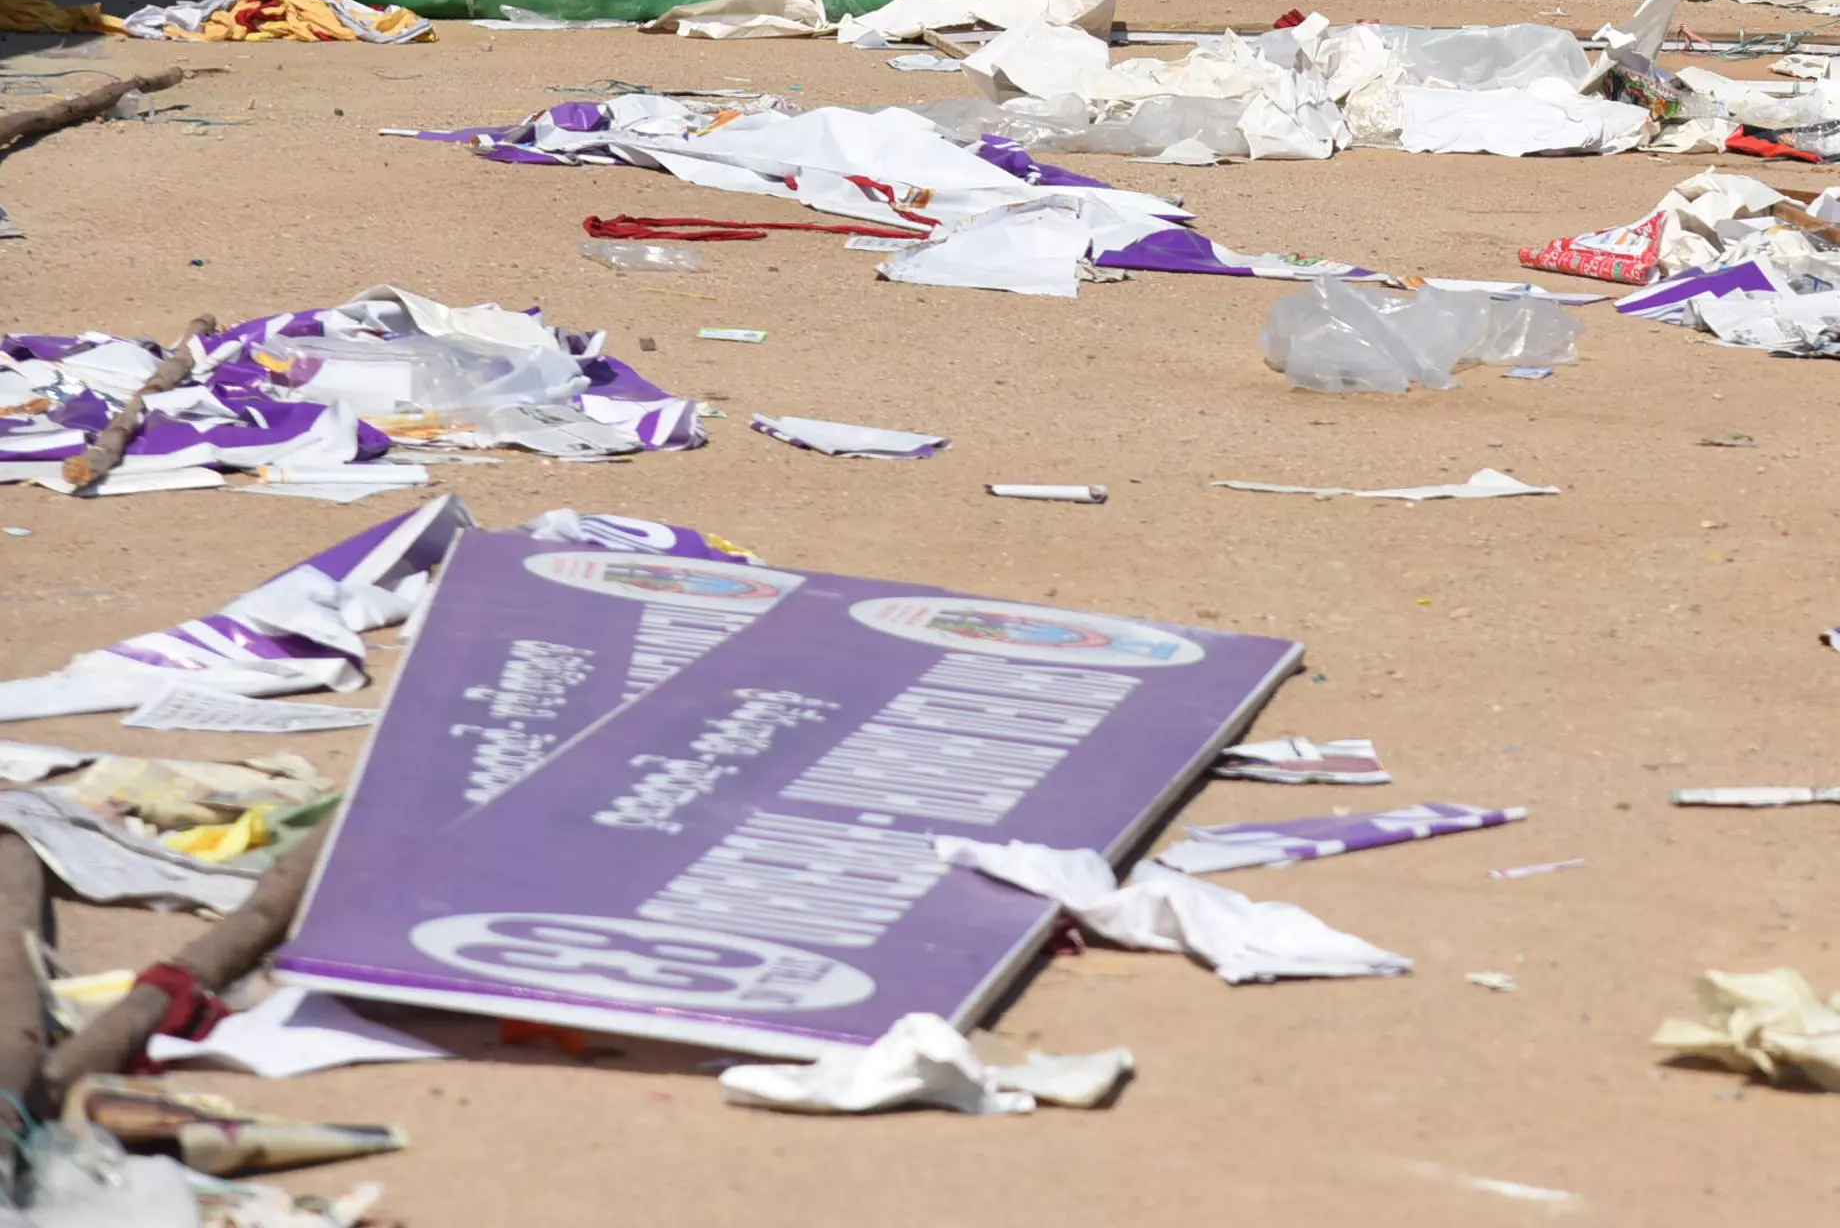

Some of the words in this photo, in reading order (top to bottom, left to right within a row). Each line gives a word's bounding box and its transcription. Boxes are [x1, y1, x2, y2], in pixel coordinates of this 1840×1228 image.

[875, 685, 1111, 746] VEDA
[780, 721, 1068, 826] BHARATHI
[634, 808, 946, 947] HYDERABAD
[455, 915, 764, 992] 83
